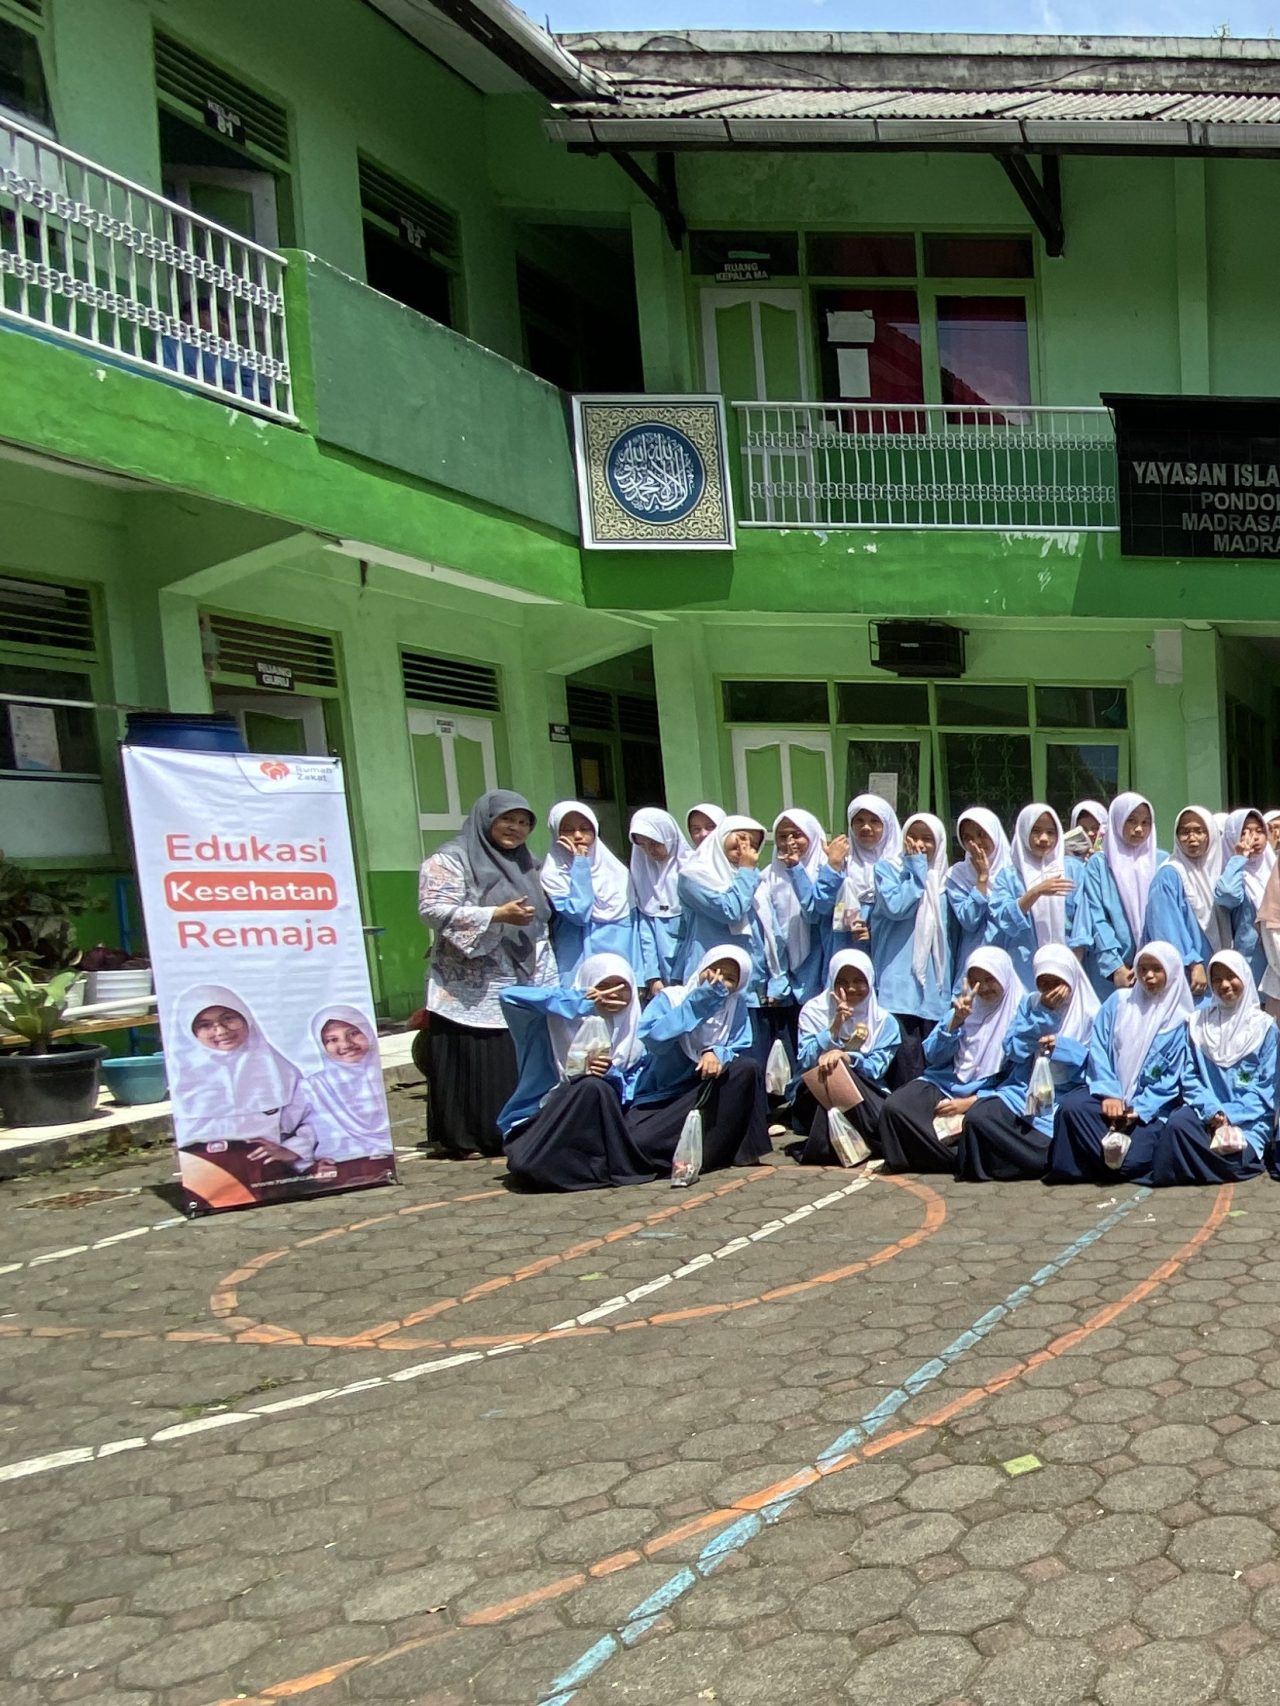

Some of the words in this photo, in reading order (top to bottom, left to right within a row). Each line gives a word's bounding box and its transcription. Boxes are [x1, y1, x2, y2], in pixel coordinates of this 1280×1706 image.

[724, 262, 759, 272] RUANG
[716, 271, 752, 281] KEPALA
[753, 270, 769, 280] MA
[1132, 461, 1227, 486] YAYASAN
[257, 662, 292, 678] RUANG
[262, 674, 290, 687] GURU
[297, 773, 328, 782] Zakat
[165, 834, 327, 863] Edukasi
[170, 880, 333, 902] Kesehatan
[177, 918, 337, 951] Remaja
